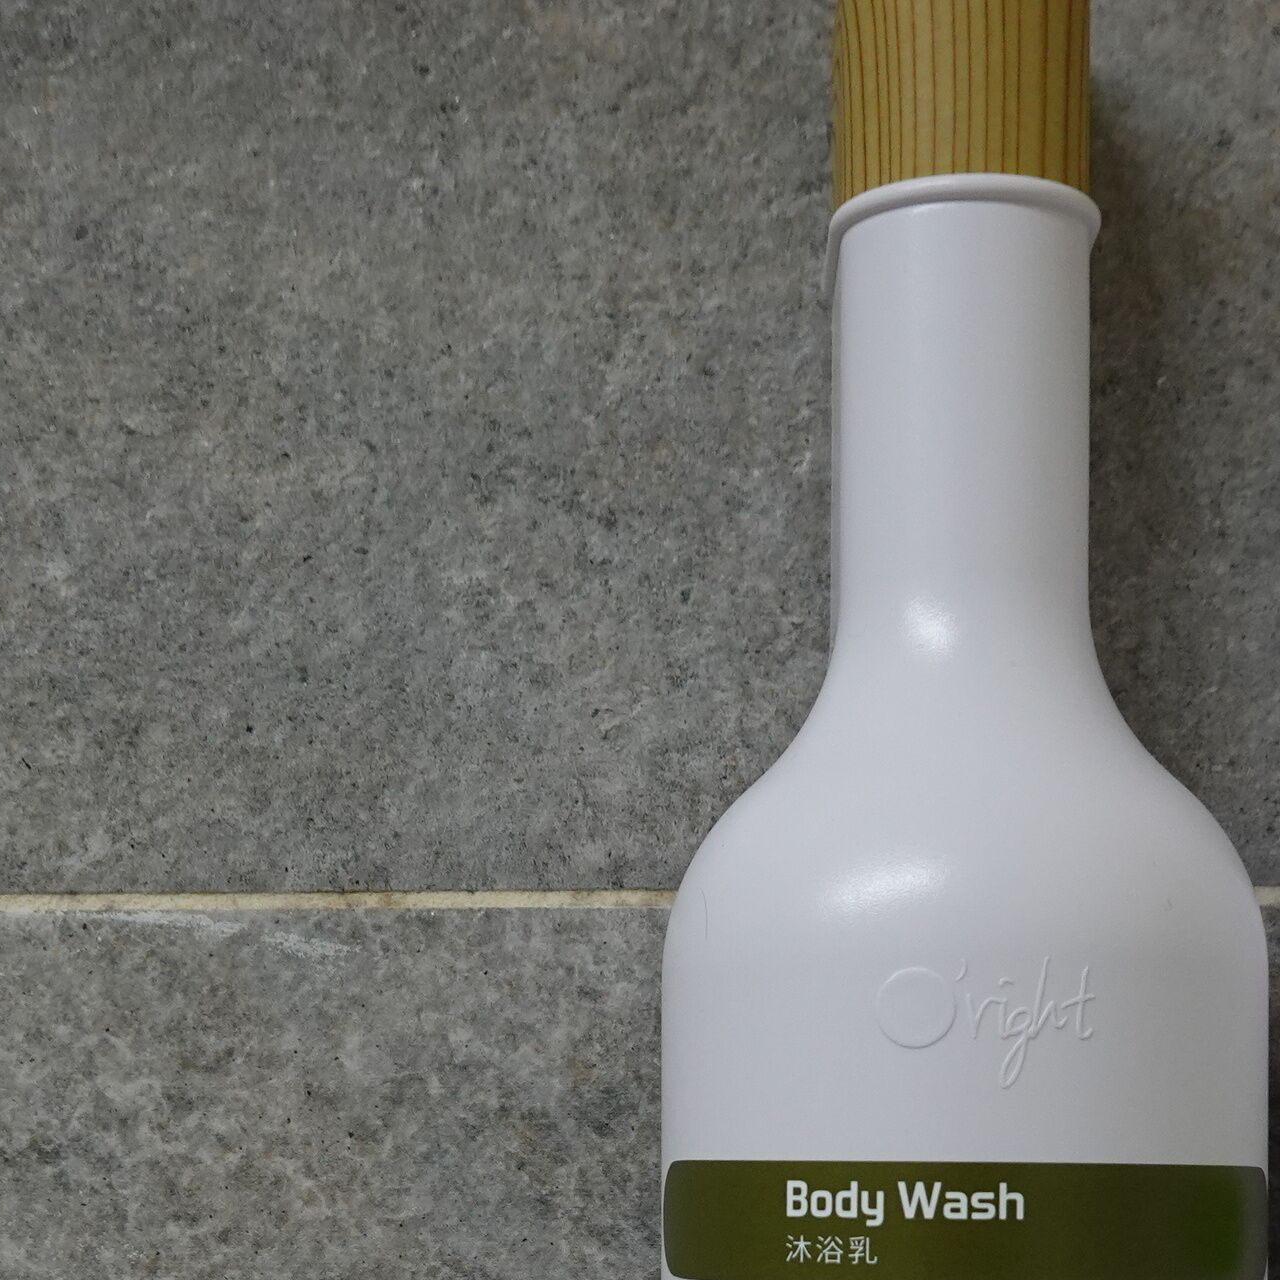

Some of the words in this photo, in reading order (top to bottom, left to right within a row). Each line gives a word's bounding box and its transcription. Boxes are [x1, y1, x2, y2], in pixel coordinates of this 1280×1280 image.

[875, 955, 1097, 1089] O'right
[785, 1179, 886, 1228] Body
[897, 1180, 1026, 1221] Wash
[784, 1233, 879, 1265] 沐浴乳
